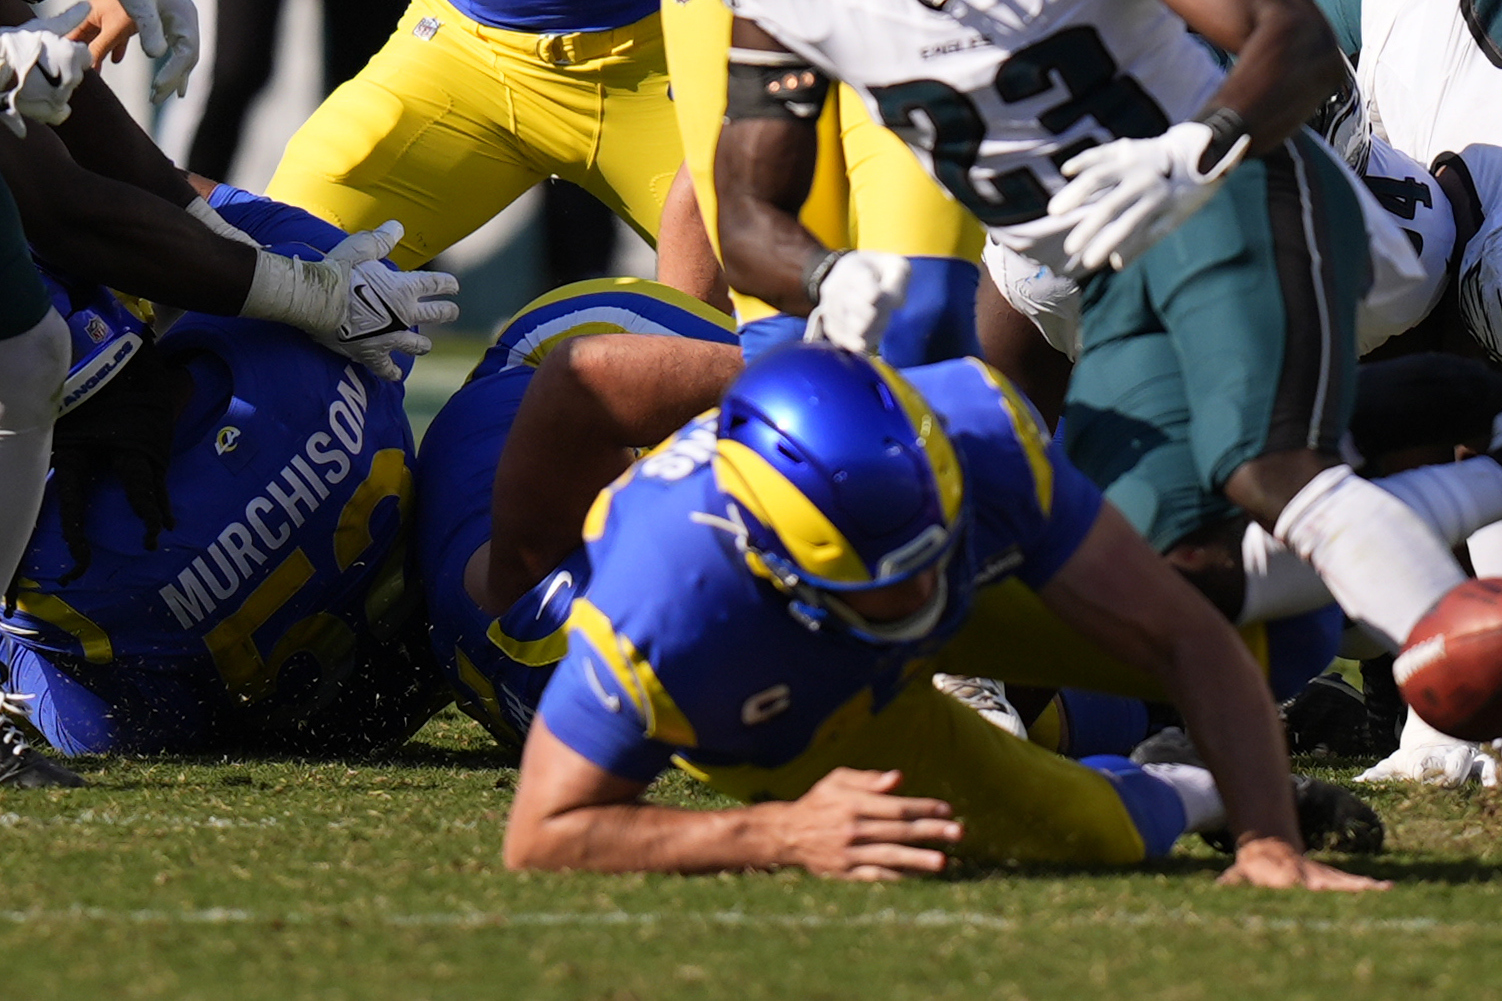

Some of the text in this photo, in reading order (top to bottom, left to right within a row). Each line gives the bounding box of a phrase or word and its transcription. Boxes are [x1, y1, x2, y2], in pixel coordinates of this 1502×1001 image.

[866, 24, 1173, 228] 23
[63, 340, 134, 408] ANGELES
[158, 363, 369, 631] MURCHISON
